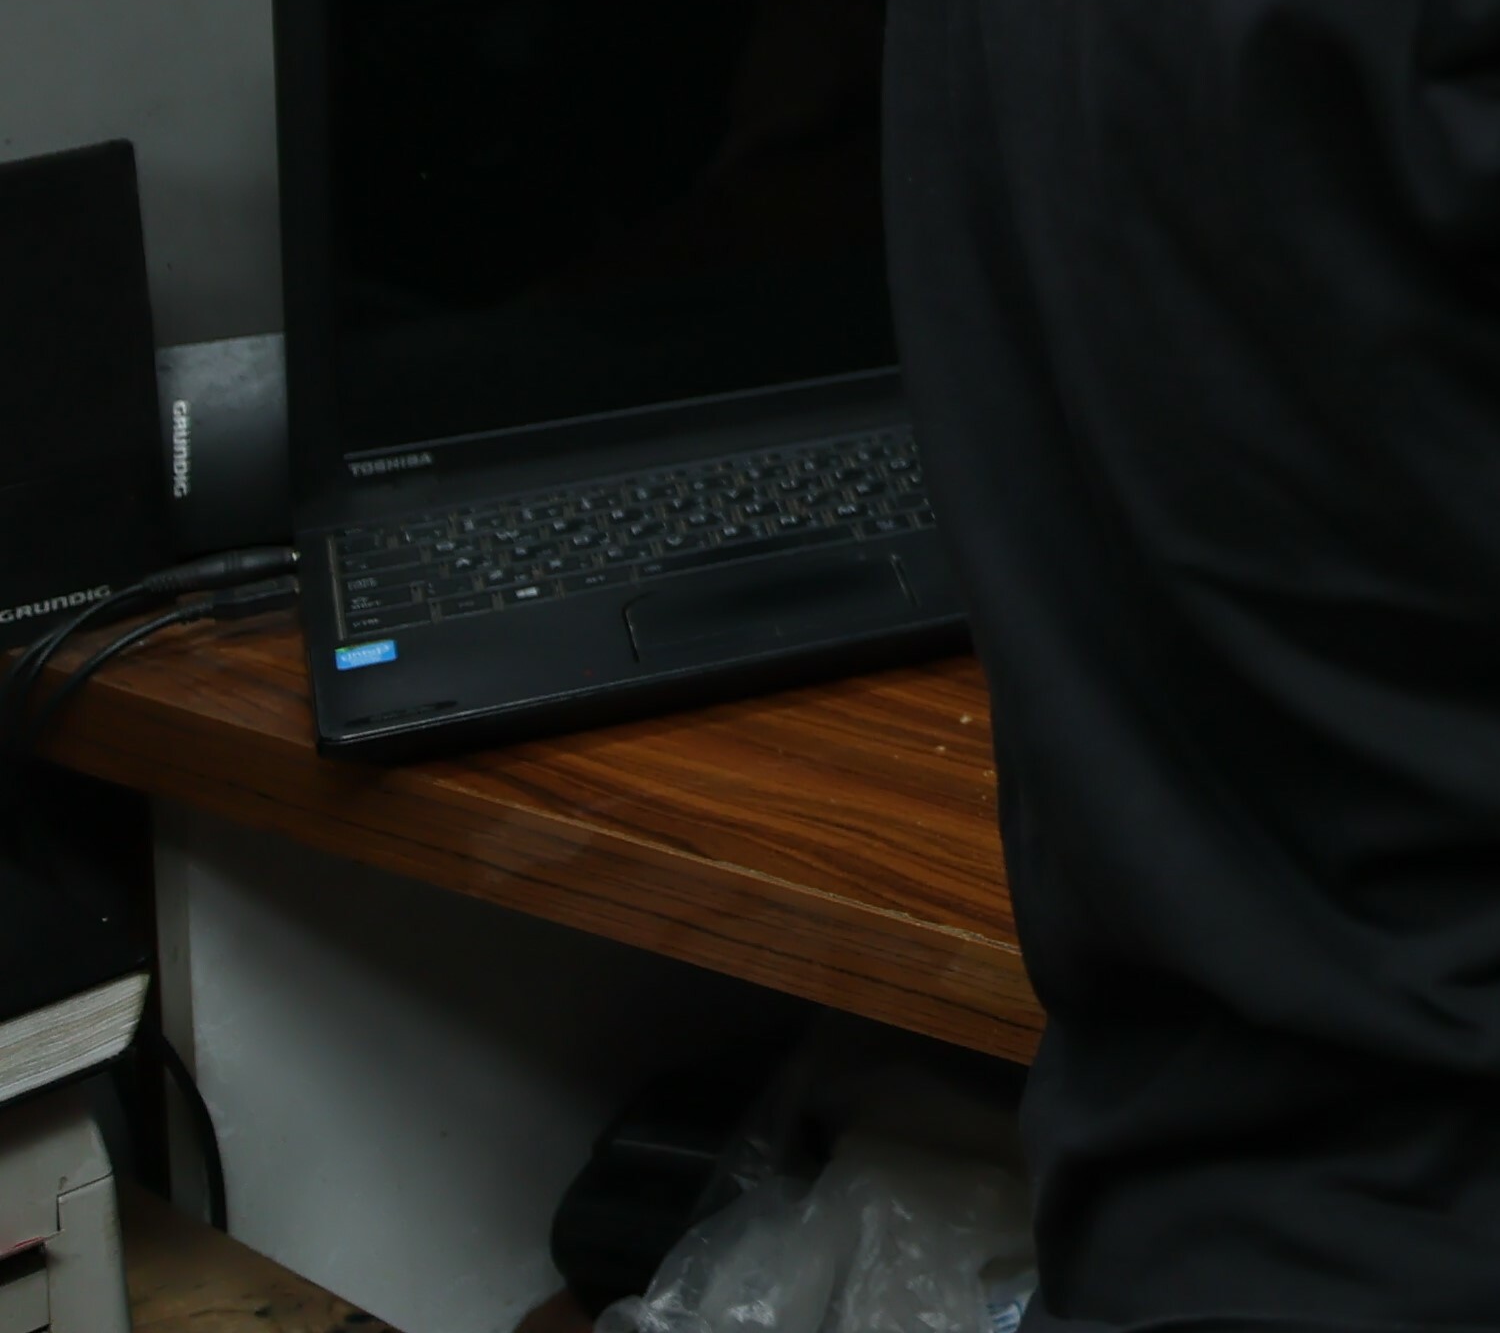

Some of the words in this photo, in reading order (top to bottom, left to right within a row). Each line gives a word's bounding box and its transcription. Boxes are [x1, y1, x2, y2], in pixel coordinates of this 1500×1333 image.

[172, 400, 190, 497] GRUNDIG
[348, 453, 432, 477] TOSHIBA
[0, 585, 112, 623] GRUNDIG
